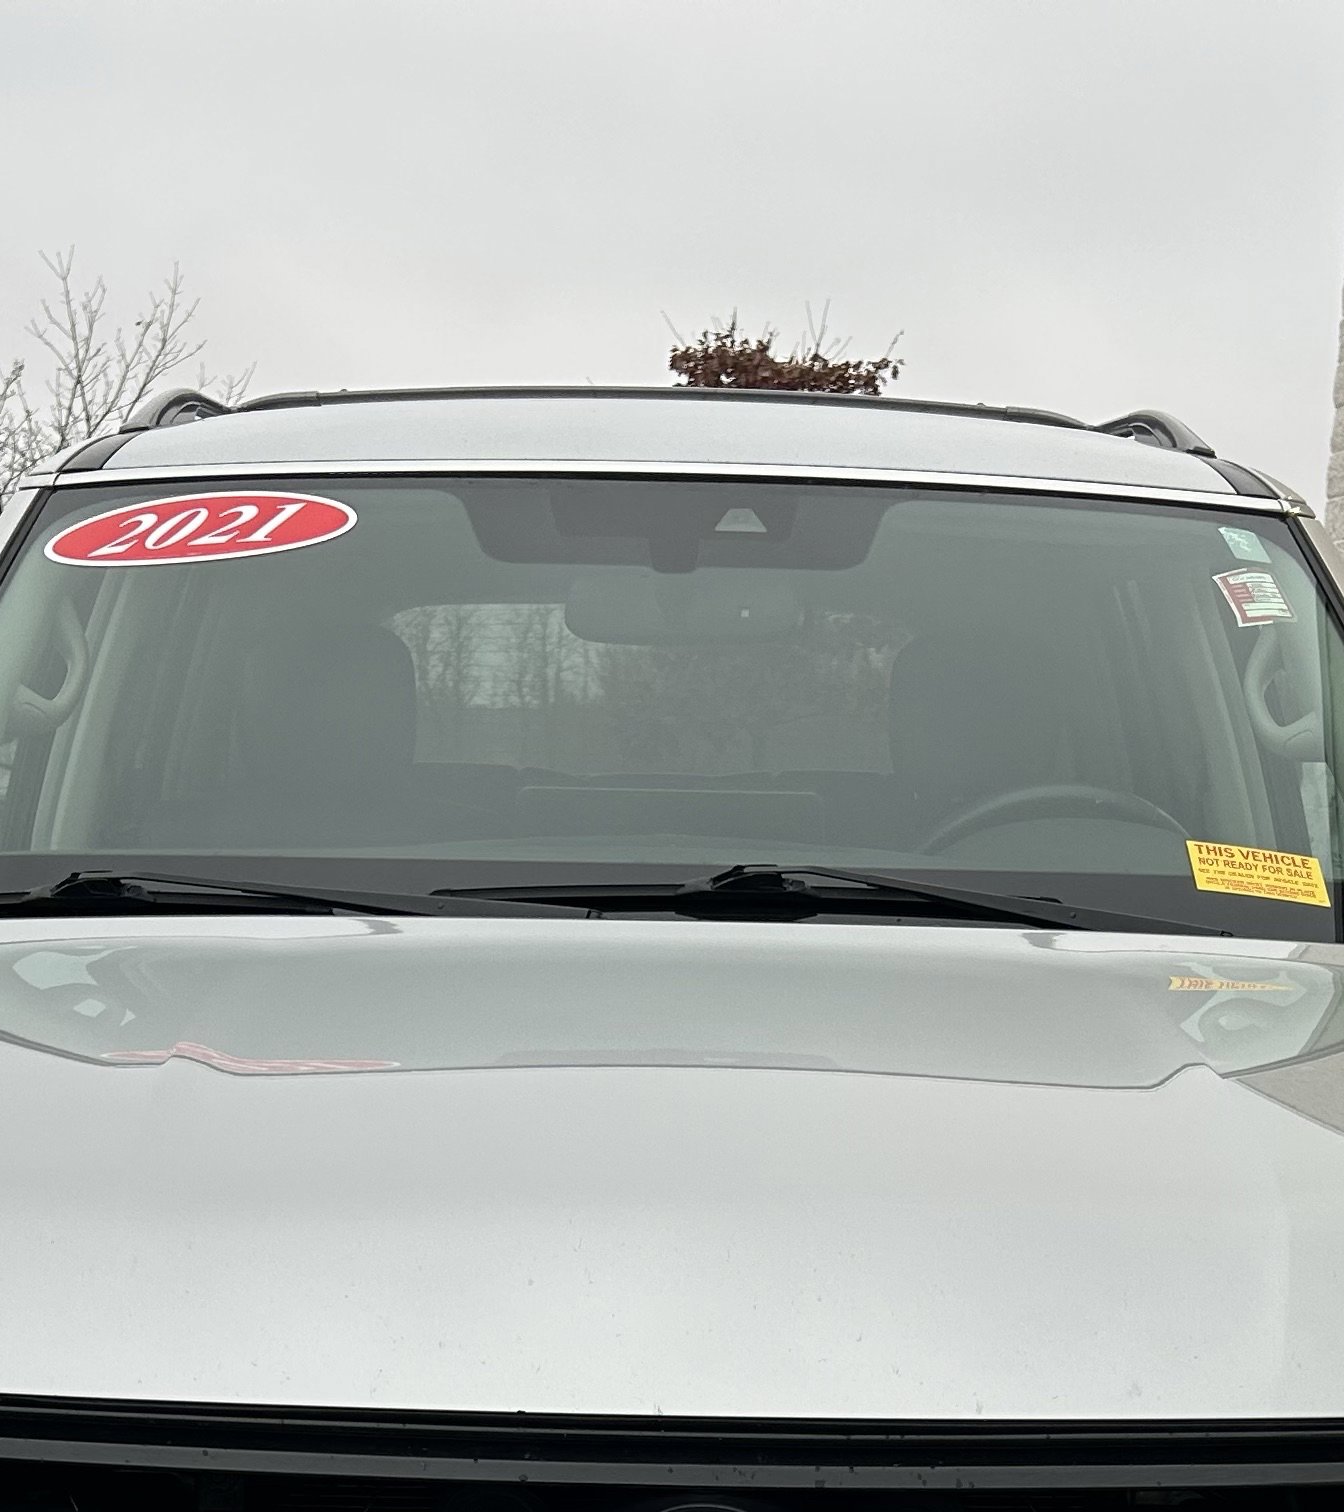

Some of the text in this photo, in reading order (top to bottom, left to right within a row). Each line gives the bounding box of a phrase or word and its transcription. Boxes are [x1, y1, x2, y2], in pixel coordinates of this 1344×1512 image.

[86, 502, 308, 559] 2021
[1195, 844, 1311, 870] THIS VEHICLE
[1198, 857, 1314, 881] NOT READY FOR SALE
